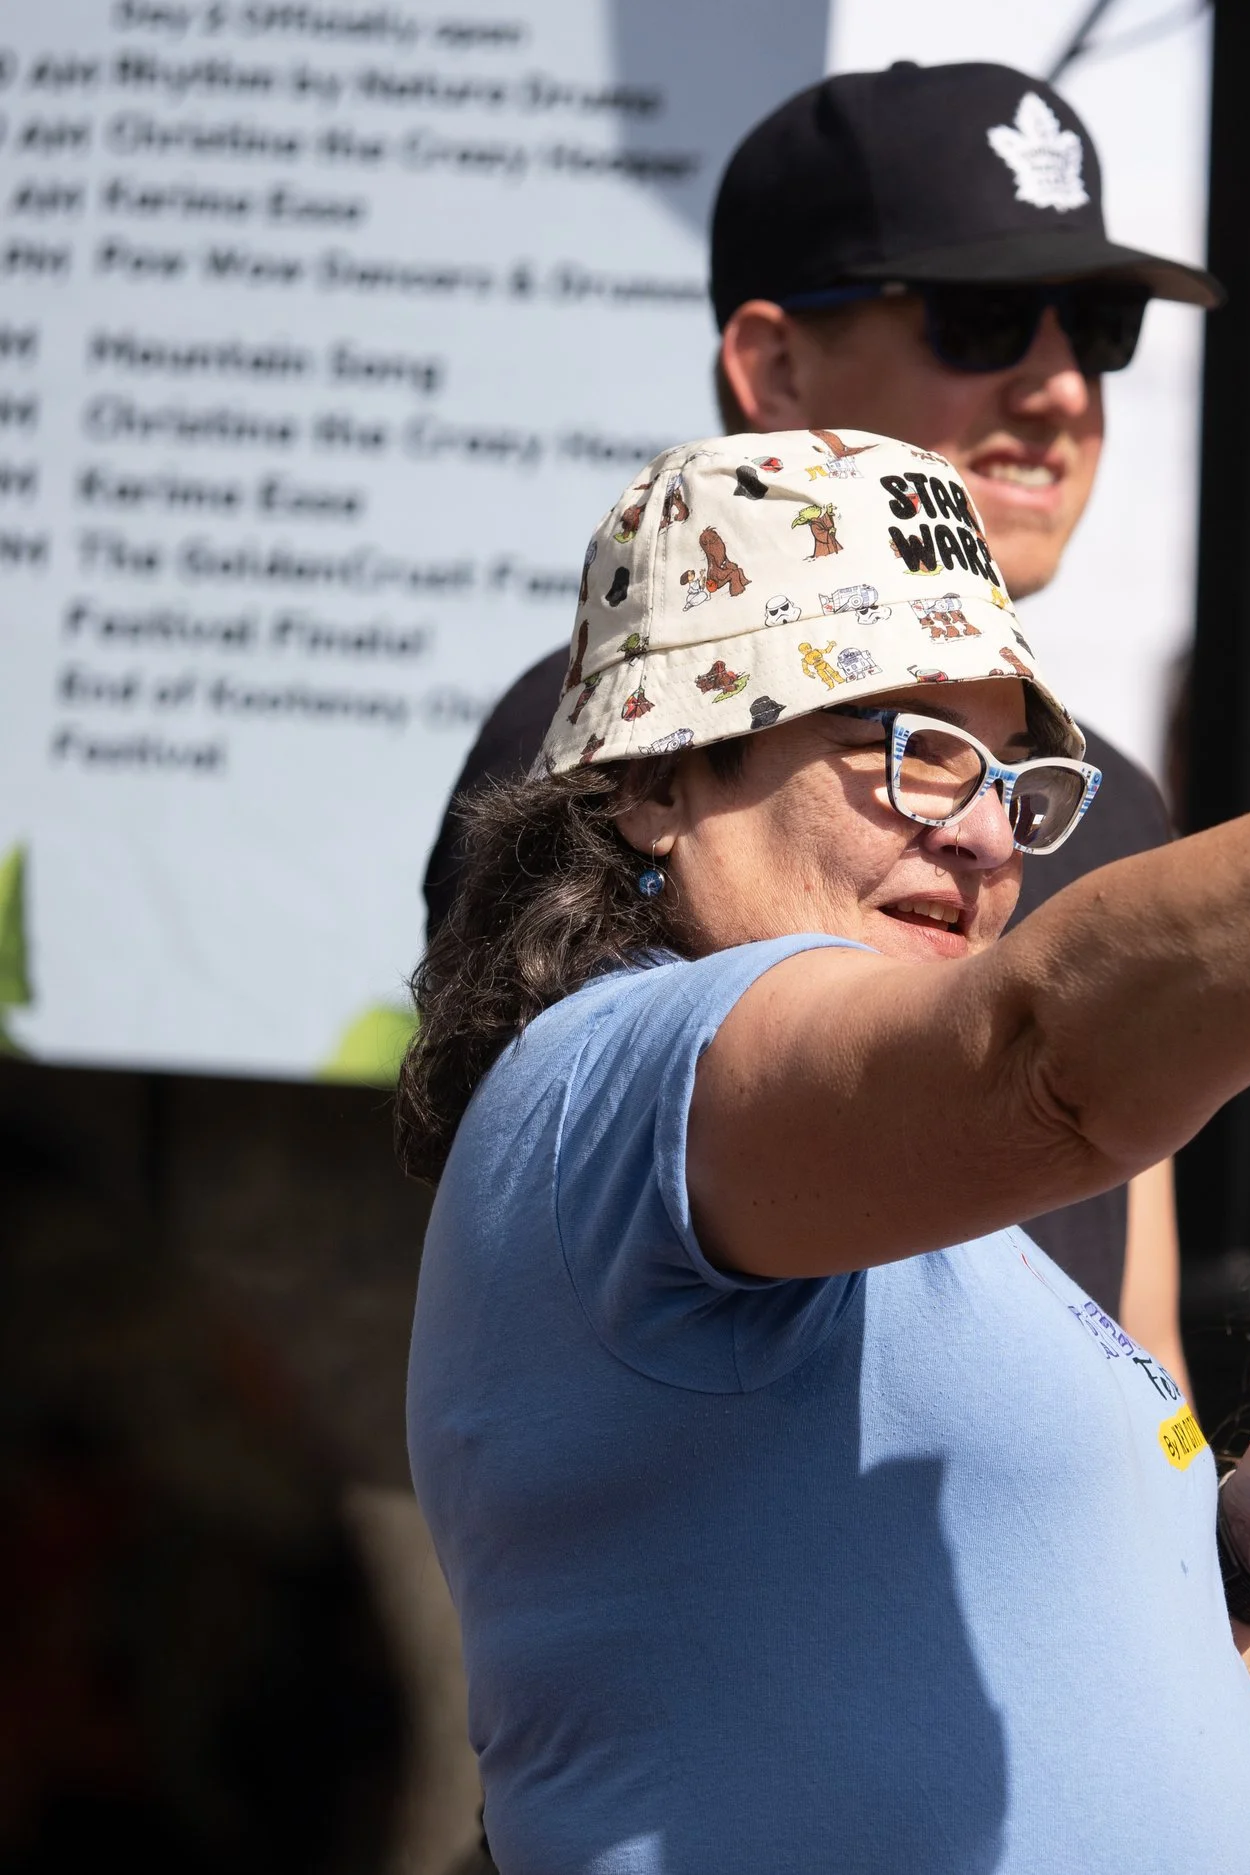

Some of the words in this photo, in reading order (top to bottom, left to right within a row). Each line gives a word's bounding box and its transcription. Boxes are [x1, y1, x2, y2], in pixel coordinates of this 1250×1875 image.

[107, 115, 300, 156] Christine
[89, 333, 312, 378] Mountain
[329, 344, 444, 396] Song
[86, 398, 299, 447] Christine
[880, 472, 980, 534] STAR
[80, 532, 163, 576] The
[888, 523, 1001, 588] WARS
[65, 600, 257, 649] Festival
[59, 667, 140, 706] End
[51, 729, 225, 772] Festival
